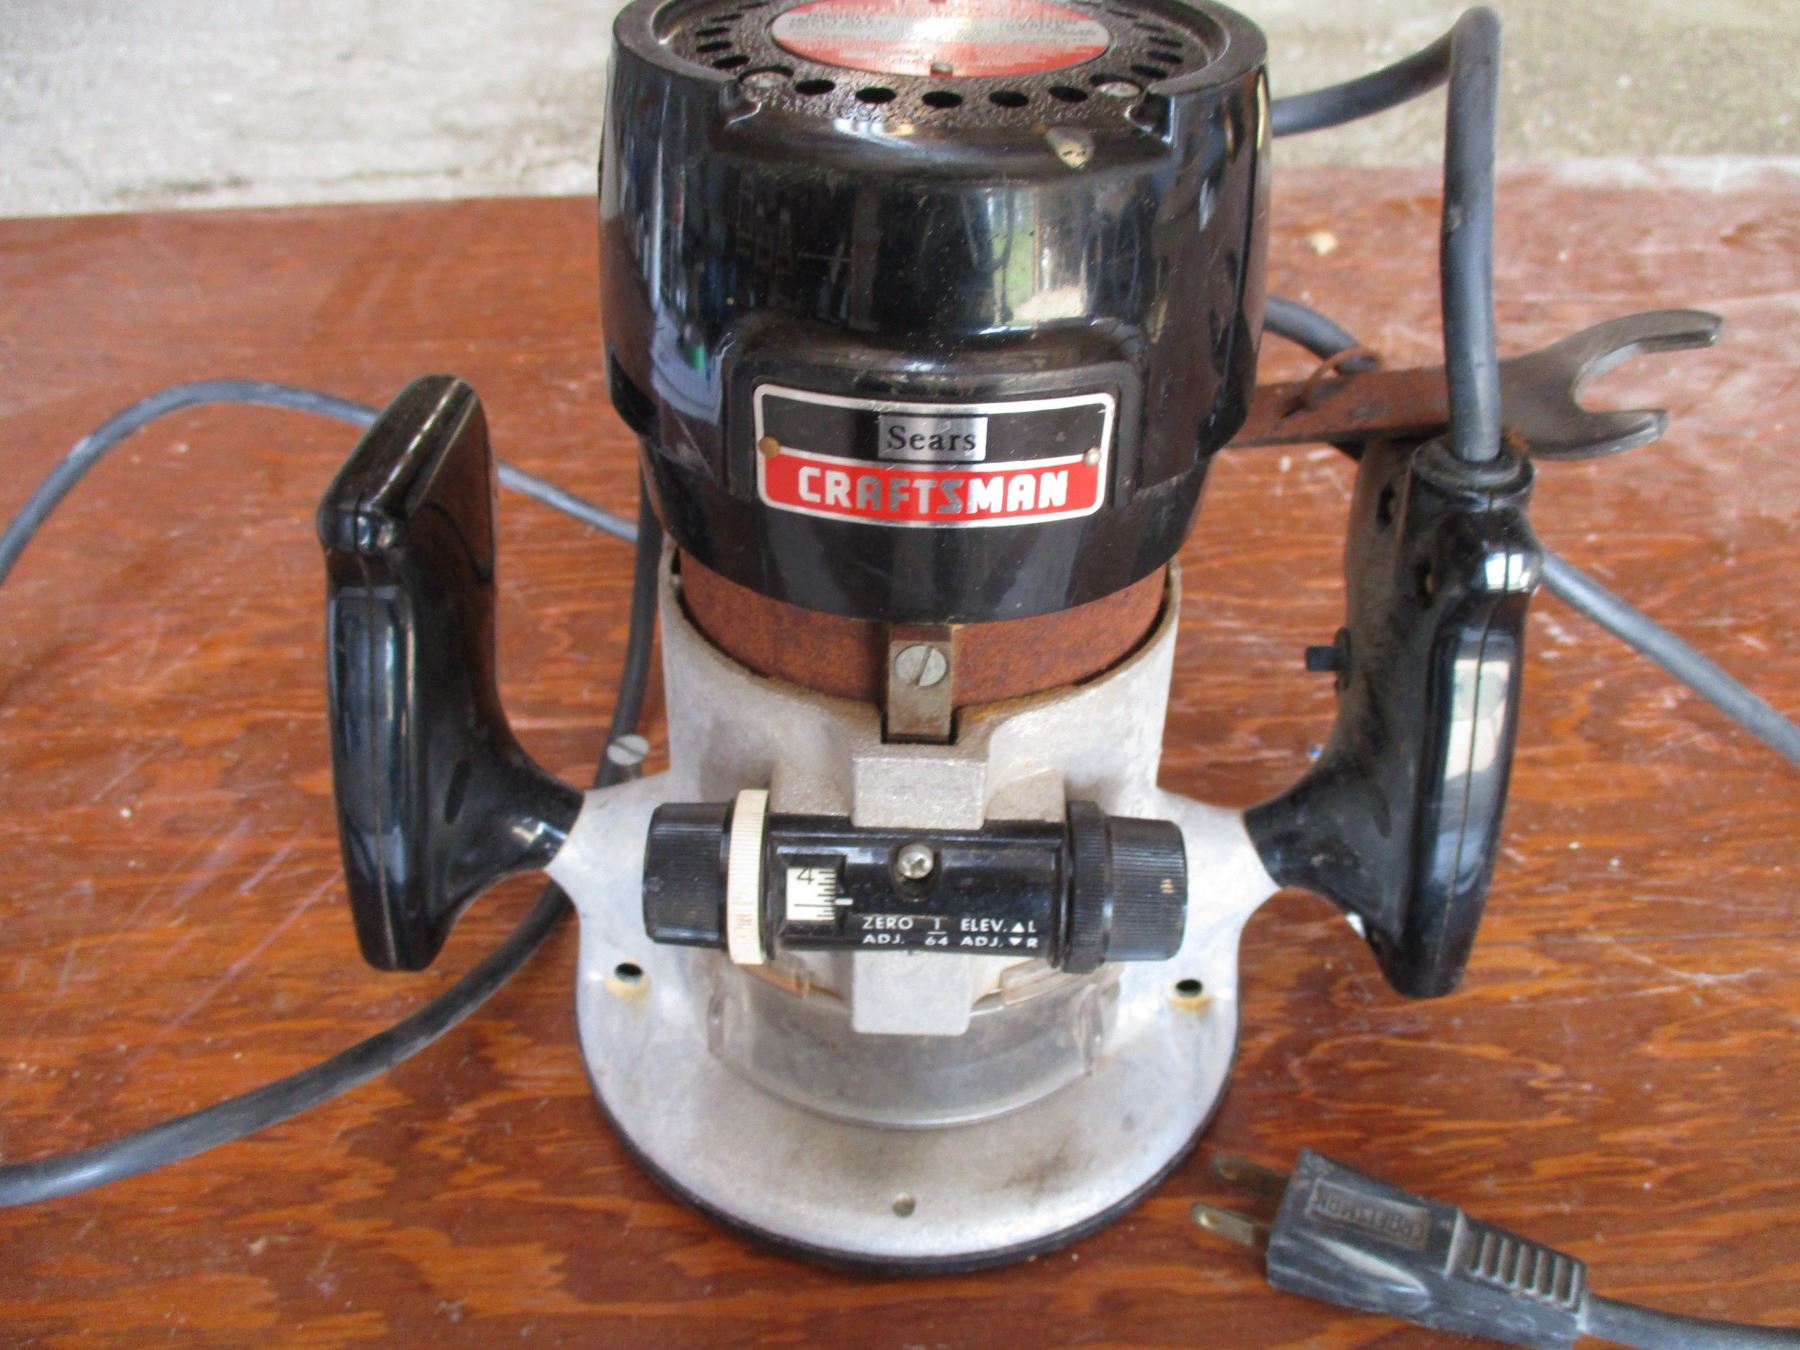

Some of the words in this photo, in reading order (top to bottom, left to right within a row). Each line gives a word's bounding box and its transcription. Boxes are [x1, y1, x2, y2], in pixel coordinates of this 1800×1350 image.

[886, 424, 977, 451] Sears
[798, 465, 1070, 515] CRAFTSMAN
[796, 864, 815, 886] 4
[861, 916, 914, 931] ZERO
[960, 918, 1008, 933] ELEV.
[861, 933, 905, 945] ADJ.
[924, 935, 949, 947] 64
[959, 935, 1005, 948] ADJ.
